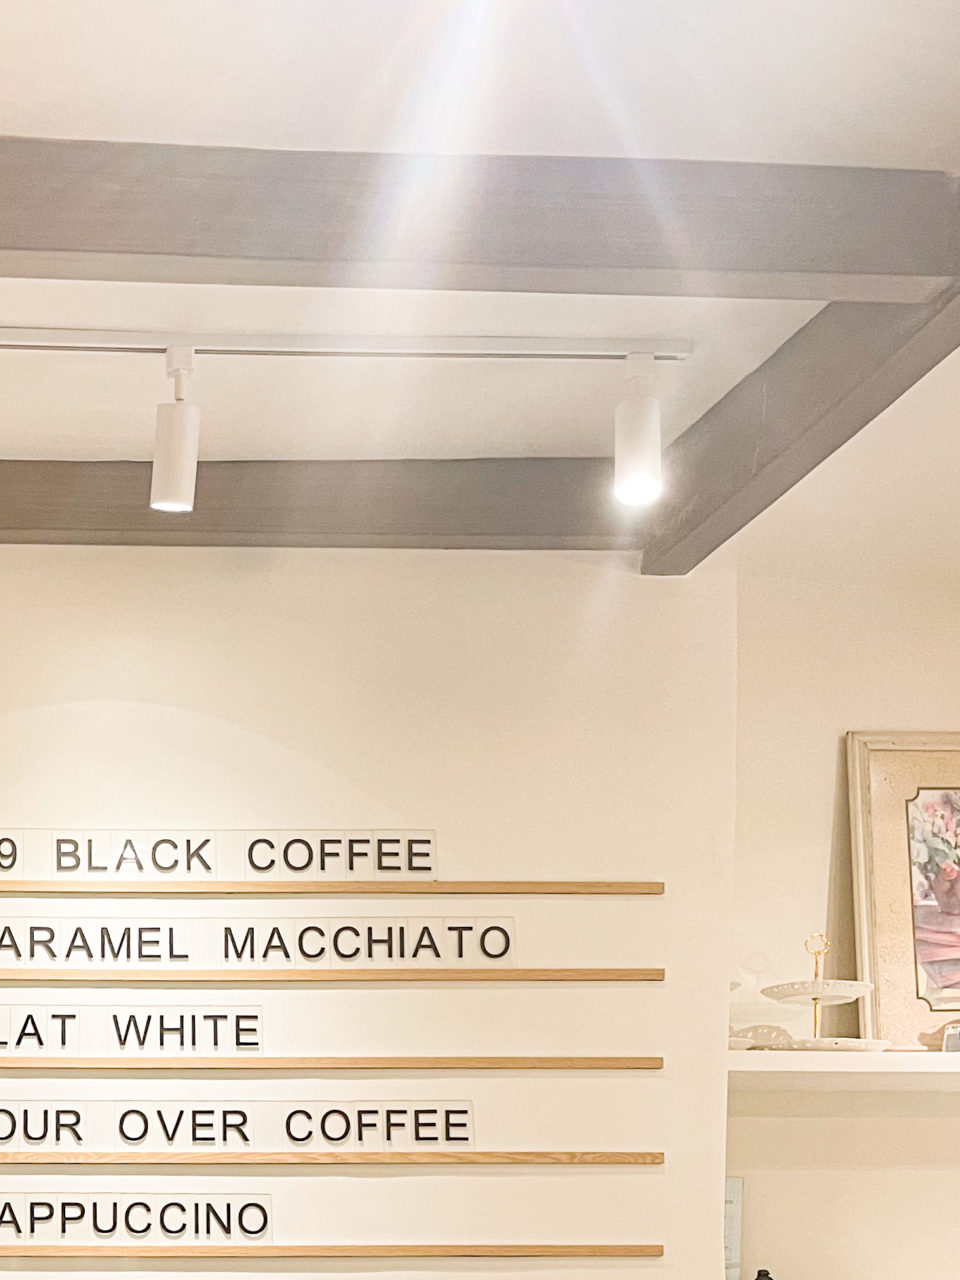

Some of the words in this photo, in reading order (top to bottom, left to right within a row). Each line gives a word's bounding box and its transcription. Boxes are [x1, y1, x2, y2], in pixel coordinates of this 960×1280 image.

[56, 838, 212, 871] BLACK
[247, 838, 432, 871] COFFEE
[224, 925, 511, 959] MACCHIATO
[112, 1014, 259, 1047] WHITE
[118, 1109, 250, 1142] OVER
[285, 1109, 470, 1142] COFFEE
